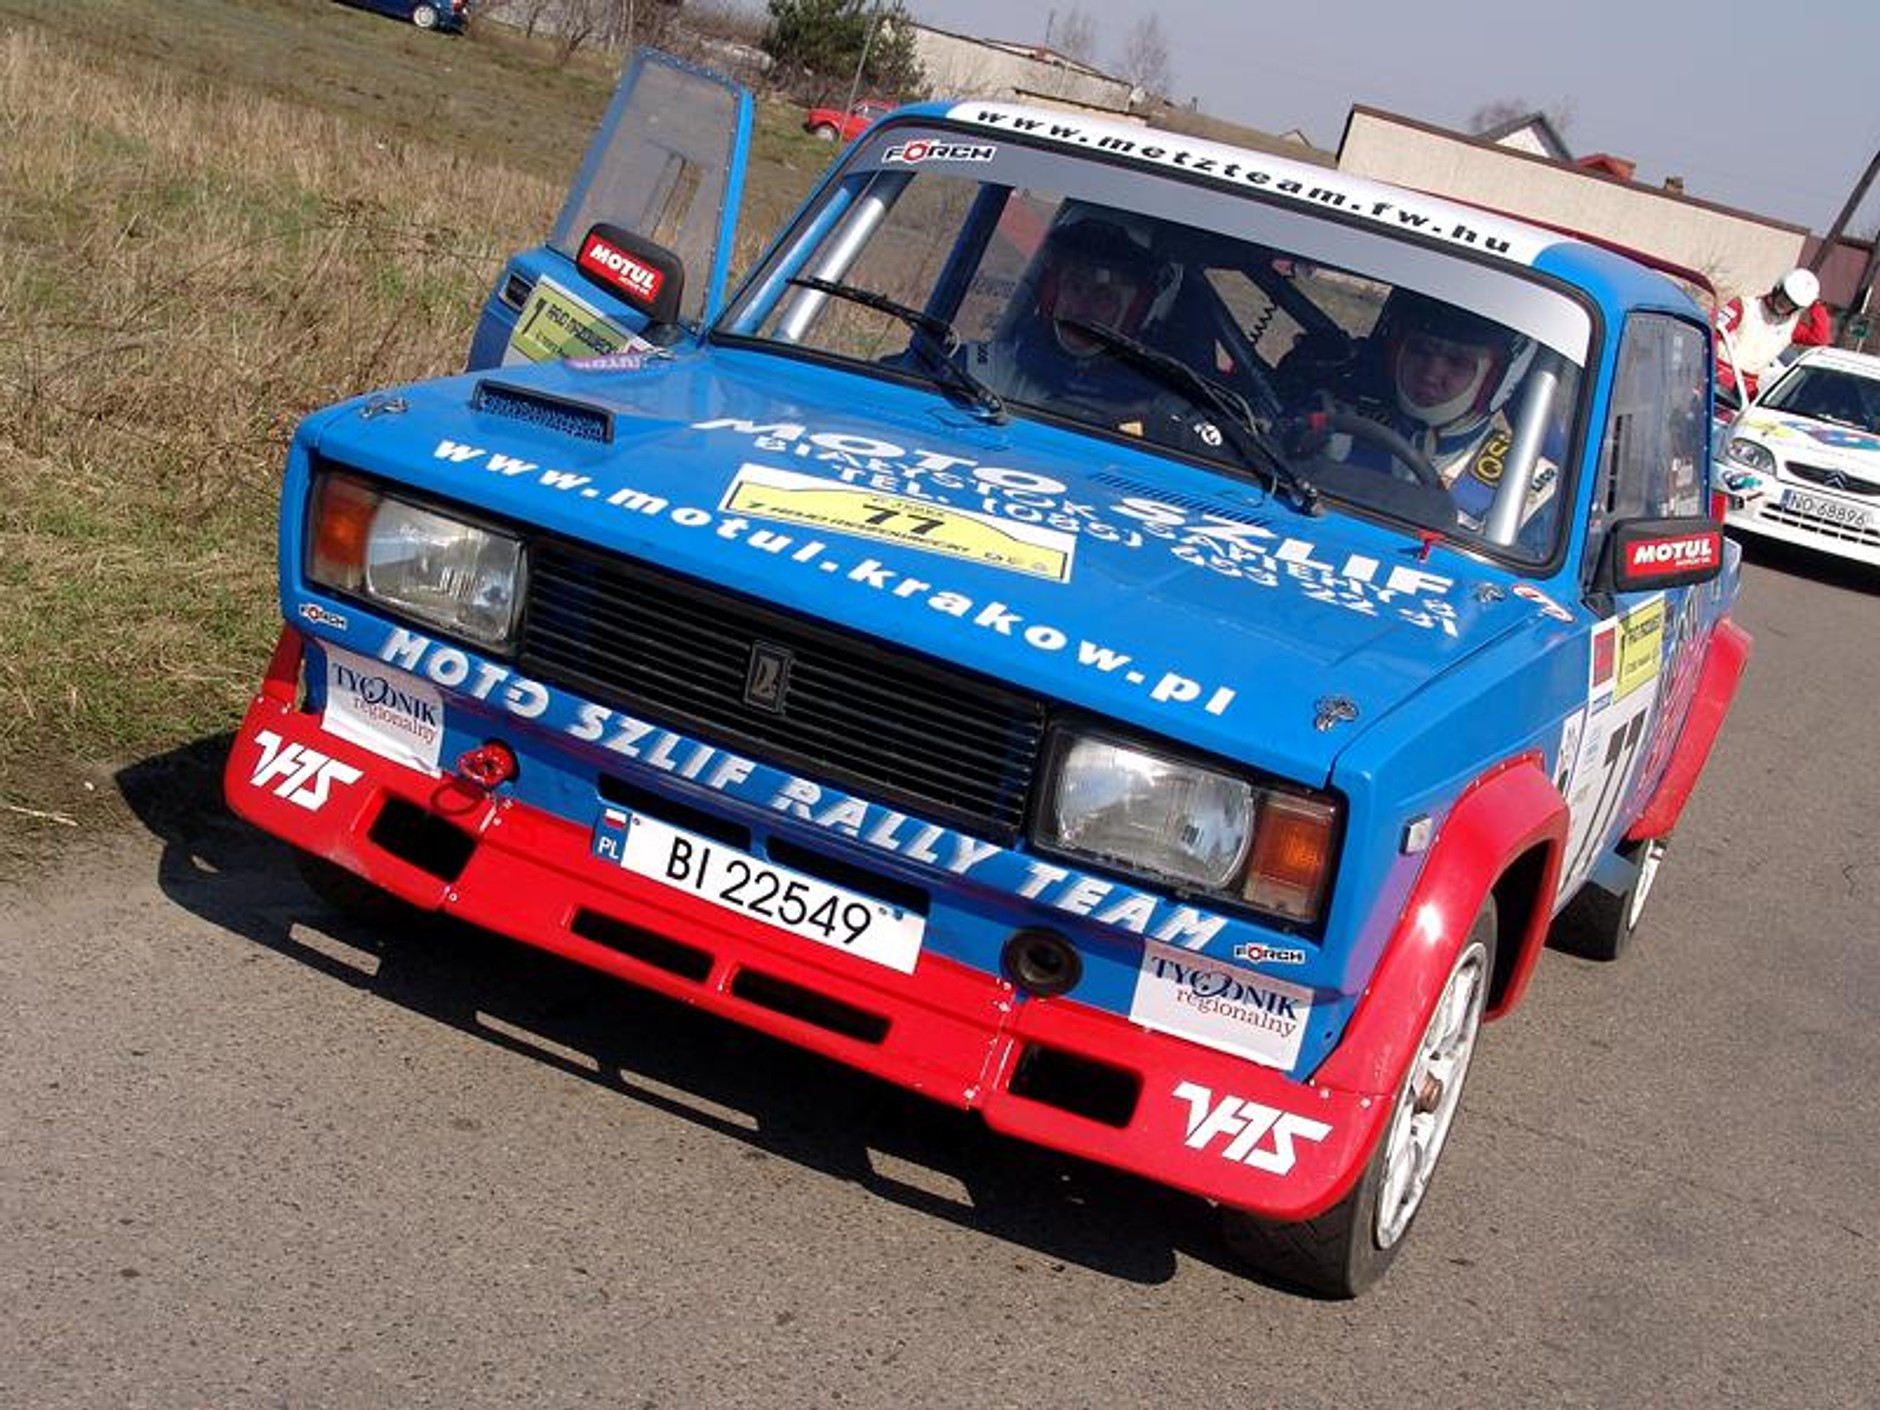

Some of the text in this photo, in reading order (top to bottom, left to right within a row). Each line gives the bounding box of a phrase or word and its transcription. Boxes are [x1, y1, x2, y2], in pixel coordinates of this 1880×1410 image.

[978, 109, 1511, 255] www.metzteam.fw.hu
[590, 244, 655, 290] MOTUL
[690, 417, 1454, 595] MOTO SZLIF
[863, 504, 945, 536] 77
[1633, 538, 1712, 565] MOTUL
[434, 440, 1237, 716] www.motul.krakow.pl
[354, 698, 437, 745] regionalny
[566, 703, 755, 789] SZLIF
[772, 781, 1003, 873] RALLY
[1014, 862, 1228, 950] TEAM
[597, 837, 619, 860] PL
[665, 836, 872, 944] BI 22549
[1176, 989, 1297, 1038] regionalny
